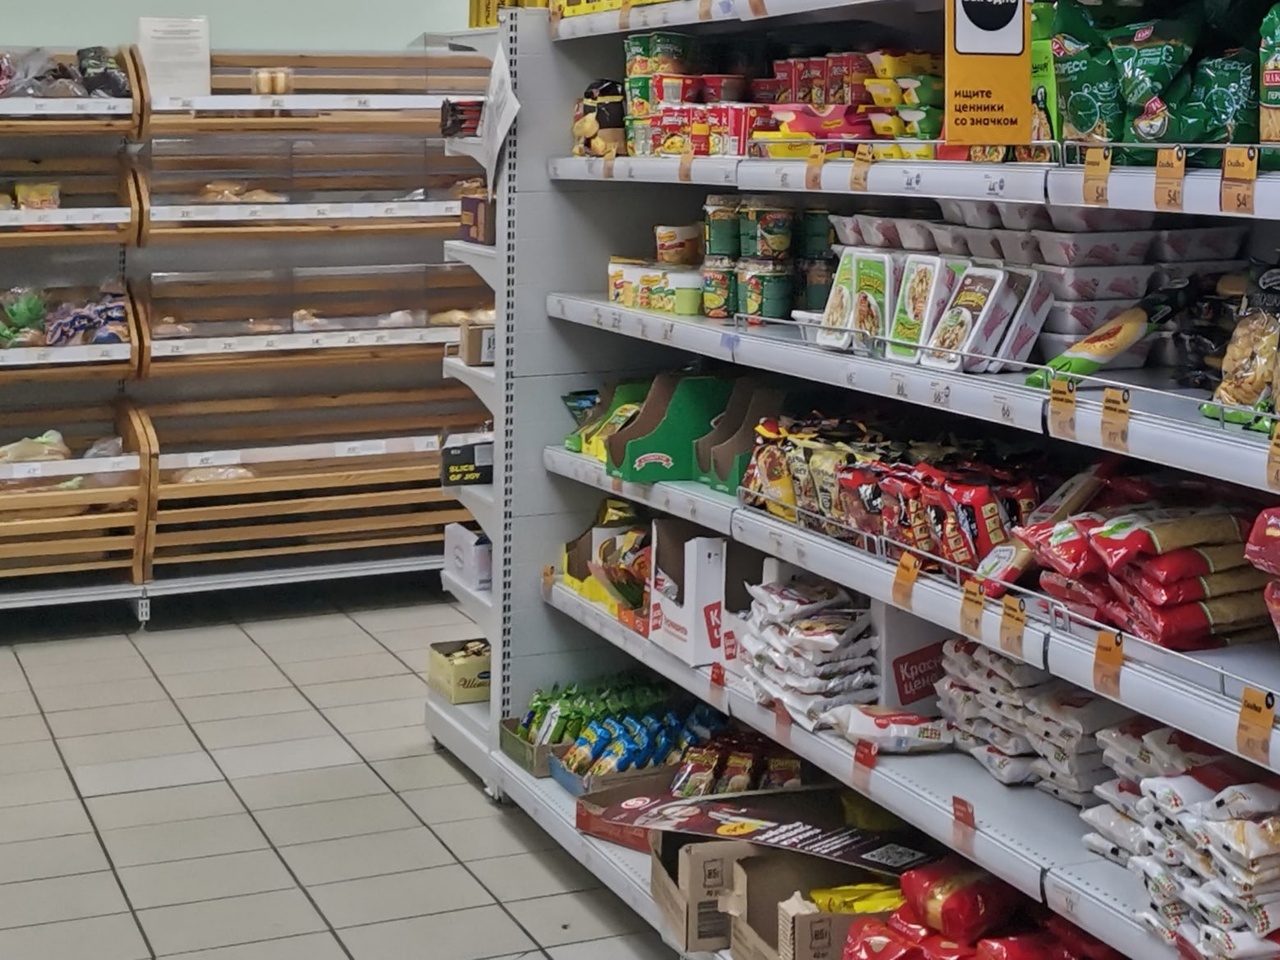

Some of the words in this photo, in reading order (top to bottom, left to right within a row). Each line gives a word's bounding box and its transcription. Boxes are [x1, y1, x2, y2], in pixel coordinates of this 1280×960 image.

[954, 89, 992, 100] ищите
[954, 102, 1004, 113] ценники
[954, 117, 967, 126] со
[971, 115, 1018, 127] значком
[449, 464, 475, 473] SLICE
[449, 474, 462, 482] OF
